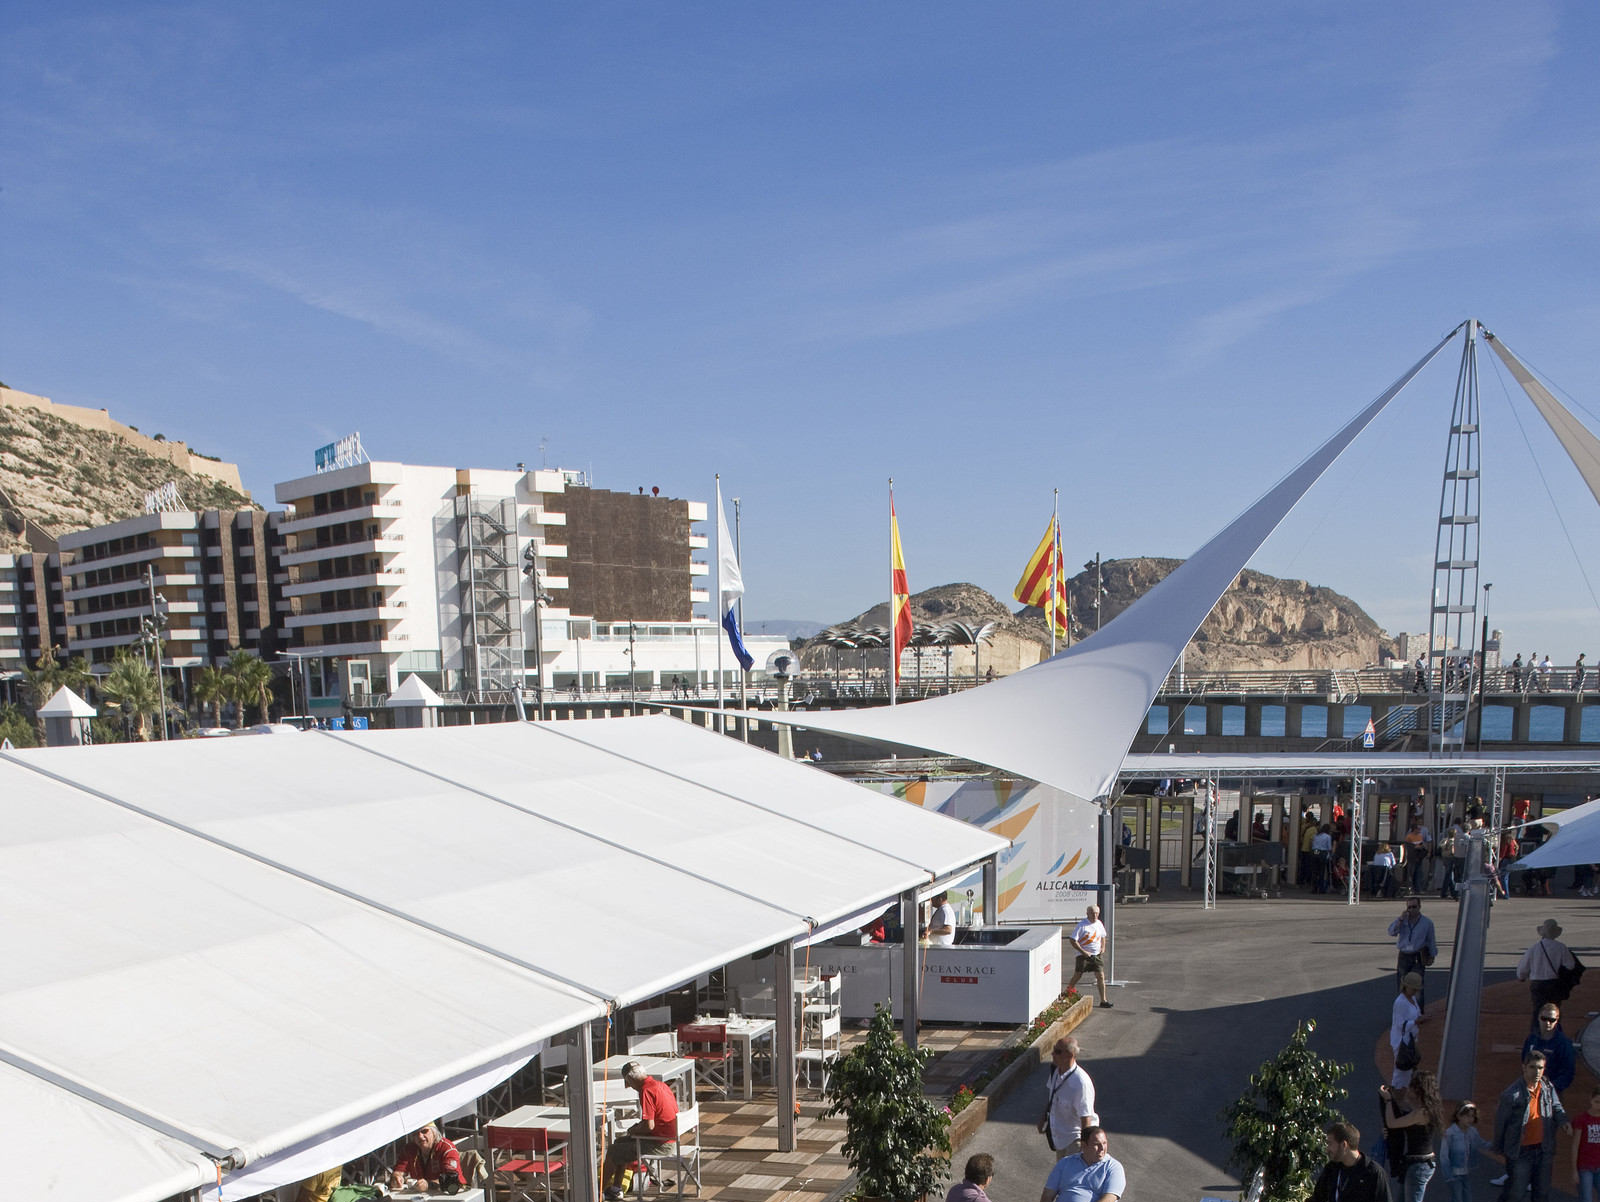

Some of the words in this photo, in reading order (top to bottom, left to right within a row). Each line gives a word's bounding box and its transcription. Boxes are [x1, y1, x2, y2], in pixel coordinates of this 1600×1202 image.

[828, 965, 857, 974] RACE
[921, 964, 961, 974] OCEAN
[966, 966, 996, 976] RACE
